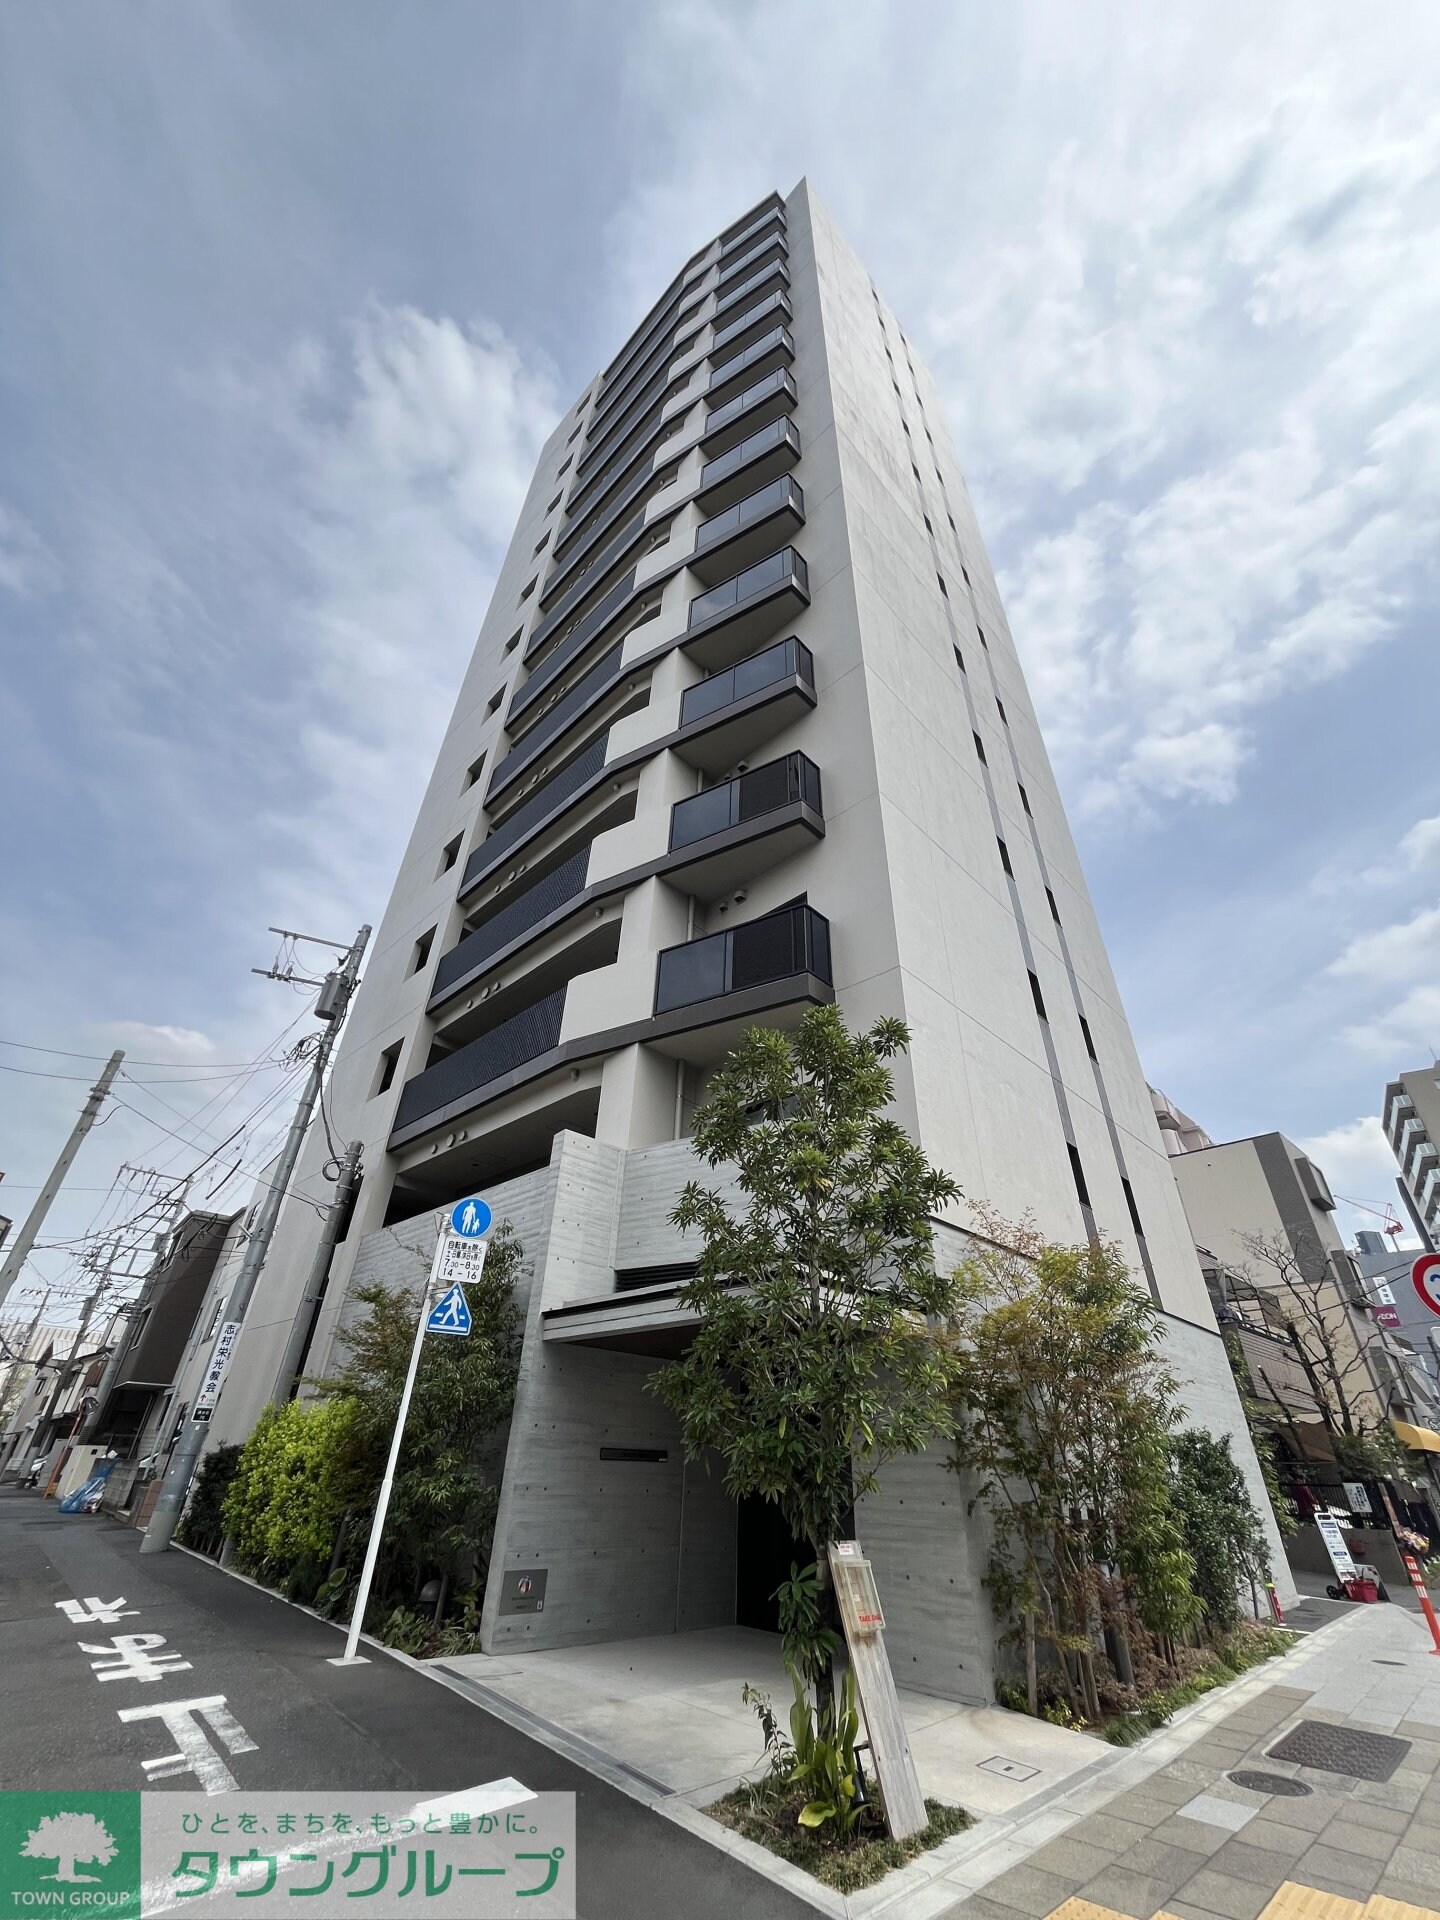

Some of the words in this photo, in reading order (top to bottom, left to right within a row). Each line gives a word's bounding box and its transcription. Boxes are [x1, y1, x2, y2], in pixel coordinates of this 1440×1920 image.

[448, 1240, 483, 1253] 自転車を除く
[204, 1323, 237, 1394] 志村栄光教会
